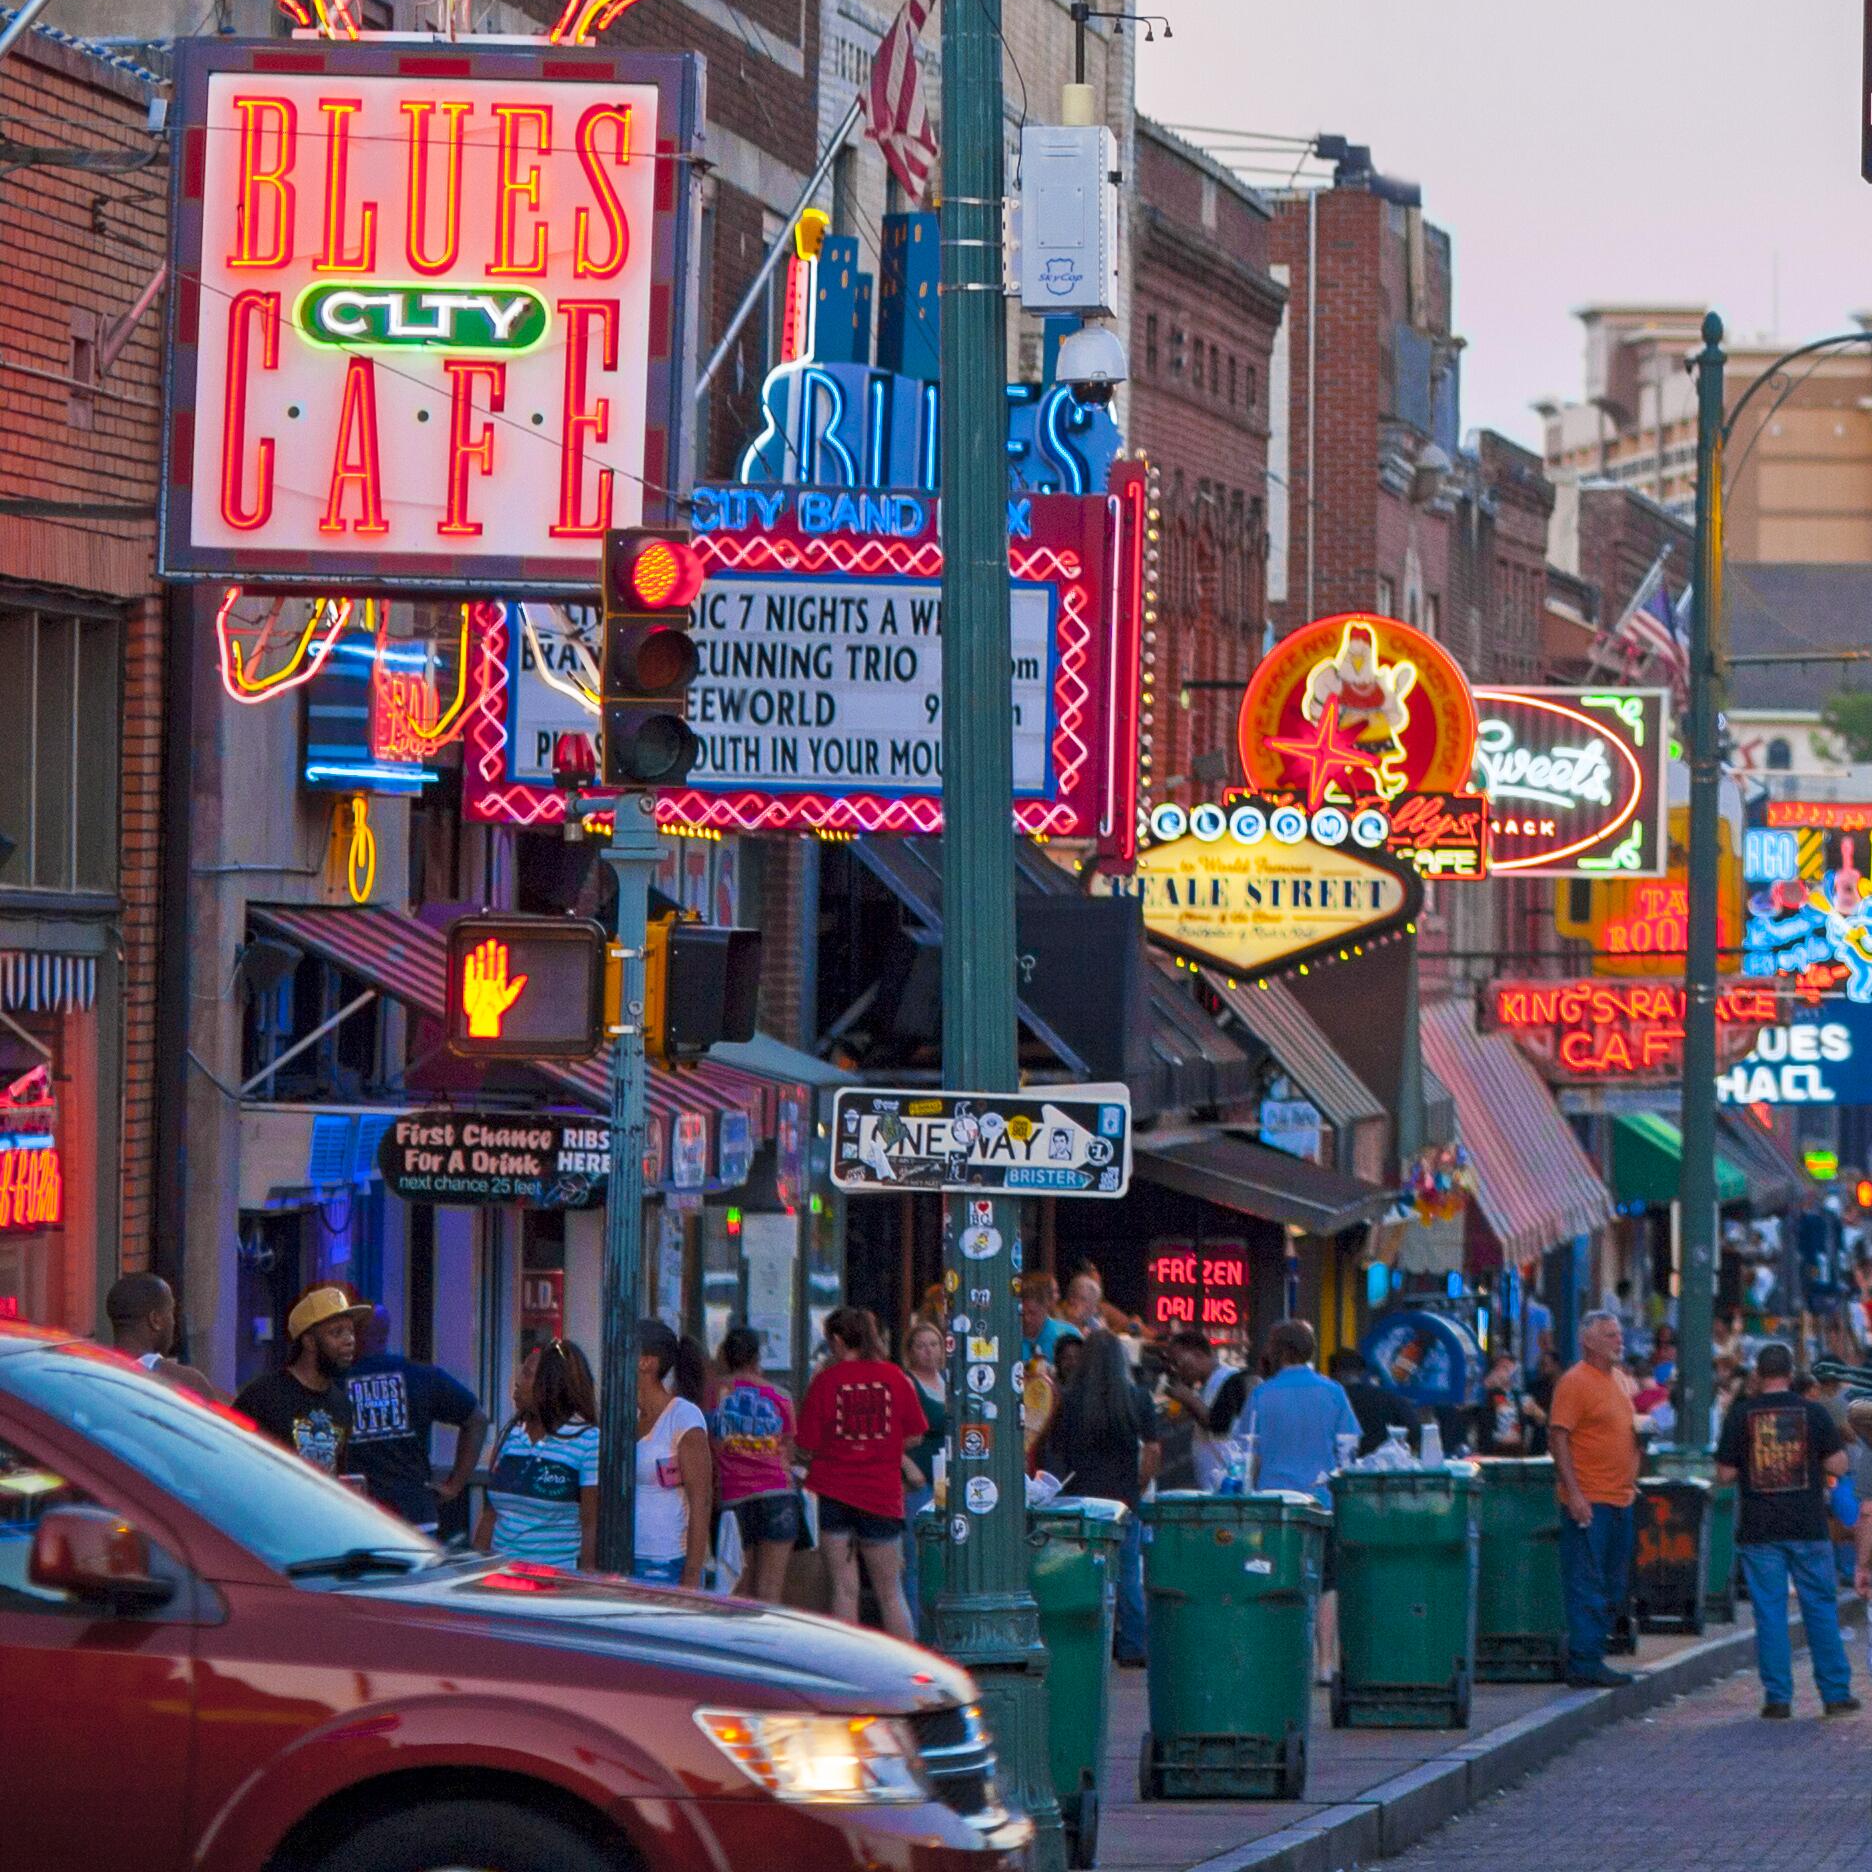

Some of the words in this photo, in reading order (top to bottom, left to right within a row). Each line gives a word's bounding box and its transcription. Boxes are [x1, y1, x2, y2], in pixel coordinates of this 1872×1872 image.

[227, 94, 632, 279] BLUES
[319, 289, 534, 341] CITY
[220, 290, 620, 539] CAFE
[690, 486, 785, 533] CITY
[797, 490, 924, 538] BAND
[739, 593, 755, 629] 7
[767, 594, 869, 635] NIGHTS
[880, 599, 900, 636] A
[845, 645, 918, 682] TRIO
[771, 736, 798, 774] IN
[807, 737, 880, 777] YOUR
[1476, 719, 1613, 807] Sweets
[1151, 803, 1390, 849] ELCOME
[1244, 877, 1388, 909] STREET
[1639, 888, 1688, 921] TA
[1607, 917, 1688, 953] ROO
[1563, 1029, 1687, 1071] CAF
[1758, 1023, 1852, 1062] UES
[396, 1122, 455, 1148] First
[462, 1123, 552, 1151] Chance
[562, 1128, 611, 1150] RIBS
[403, 1148, 445, 1174] For
[448, 1149, 466, 1175] A
[470, 1150, 542, 1176] Drink
[557, 1151, 612, 1174] HERE
[1009, 1169, 1076, 1186] BRISTER
[398, 1175, 432, 1192] next
[433, 1175, 489, 1194] chance
[490, 1177, 511, 1195] 25
[513, 1179, 543, 1196] feet
[354, 1376, 400, 1404] BLUES
[355, 1402, 401, 1431] CAFE
